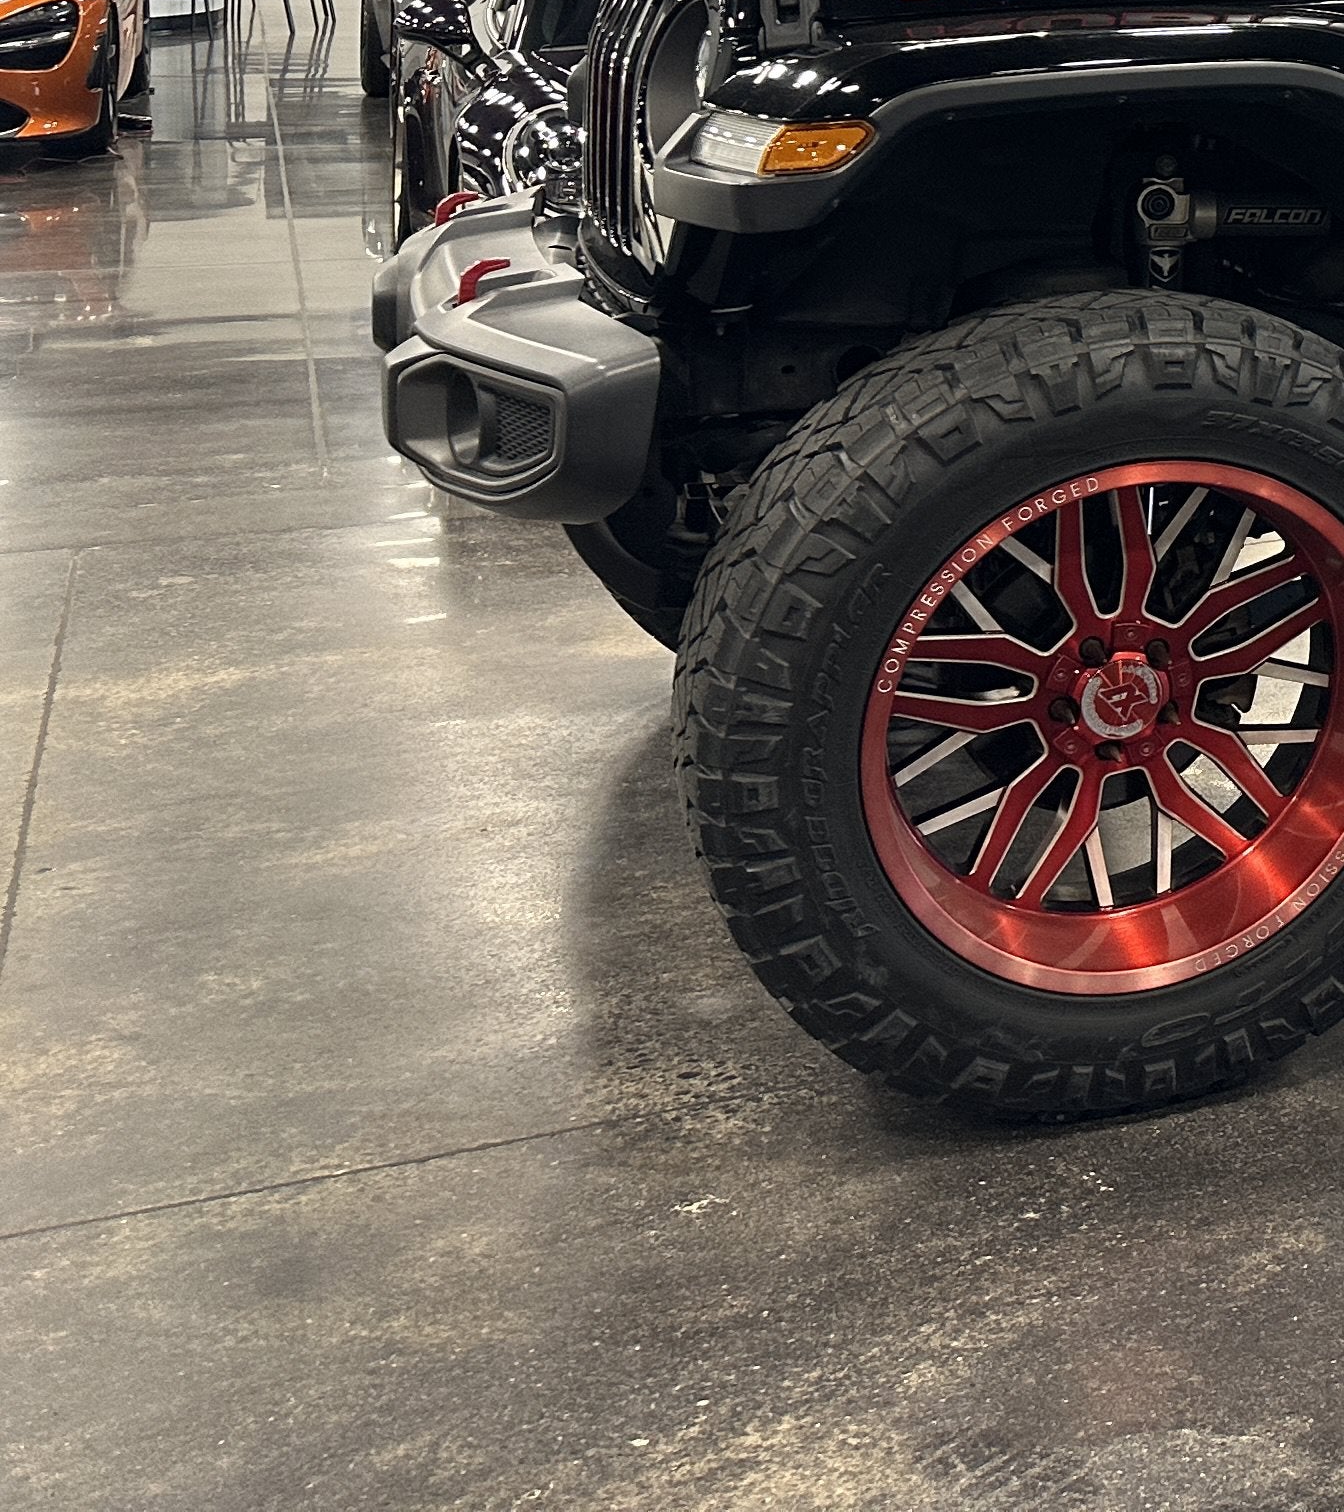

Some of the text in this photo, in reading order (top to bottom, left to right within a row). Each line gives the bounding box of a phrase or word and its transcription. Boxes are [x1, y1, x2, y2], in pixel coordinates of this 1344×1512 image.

[1227, 208, 1322, 224] FALCON
[877, 477, 1099, 694] COMPRESSION FORGED
